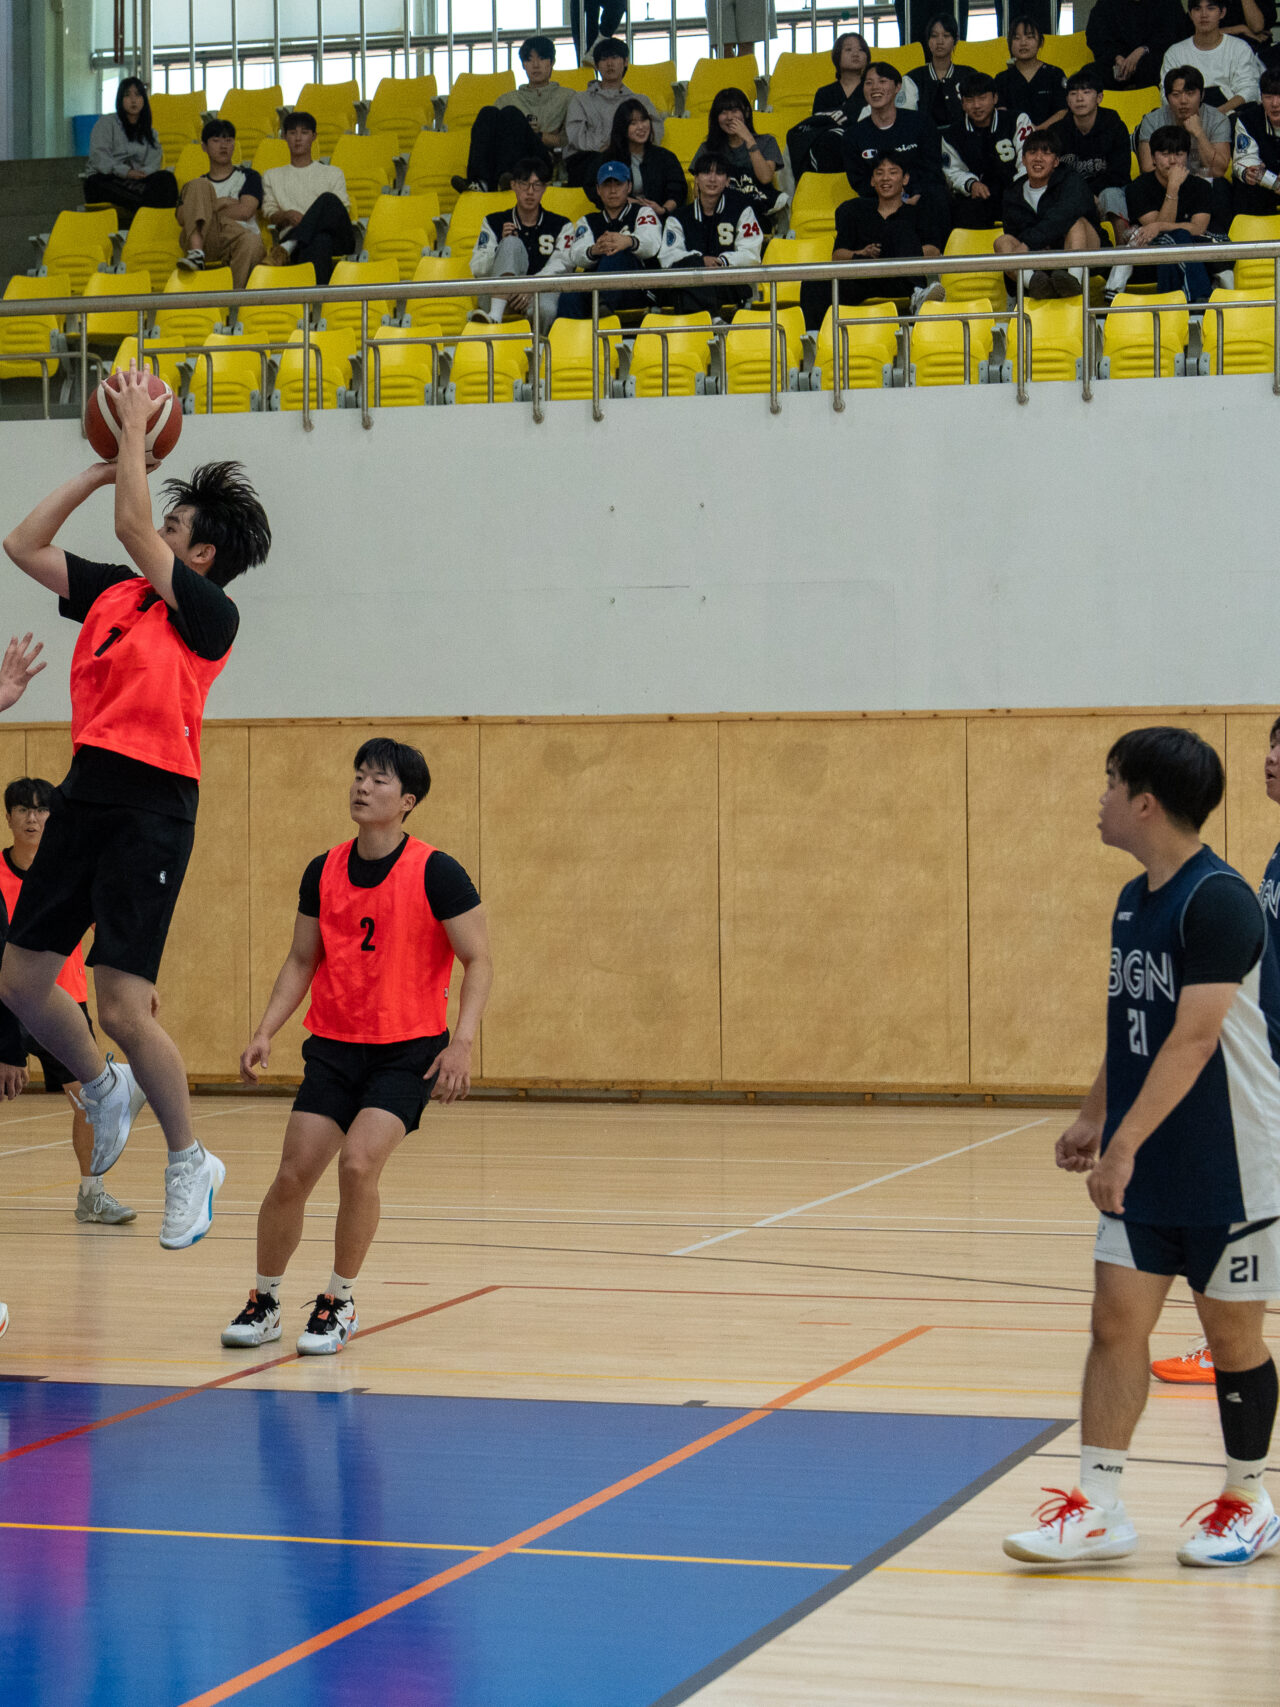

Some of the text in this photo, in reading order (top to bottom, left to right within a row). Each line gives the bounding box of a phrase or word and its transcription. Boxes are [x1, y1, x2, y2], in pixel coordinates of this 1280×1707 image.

[995, 138, 1016, 163] S
[637, 215, 657, 226] 23
[742, 221, 760, 238] 24
[538, 234, 555, 255] S
[564, 235, 575, 249] 2
[717, 222, 734, 246] S
[360, 916, 376, 952] 2
[1108, 948, 1175, 1002] BGN
[1127, 1007, 1149, 1057] 21
[1229, 1254, 1259, 1283] 21
